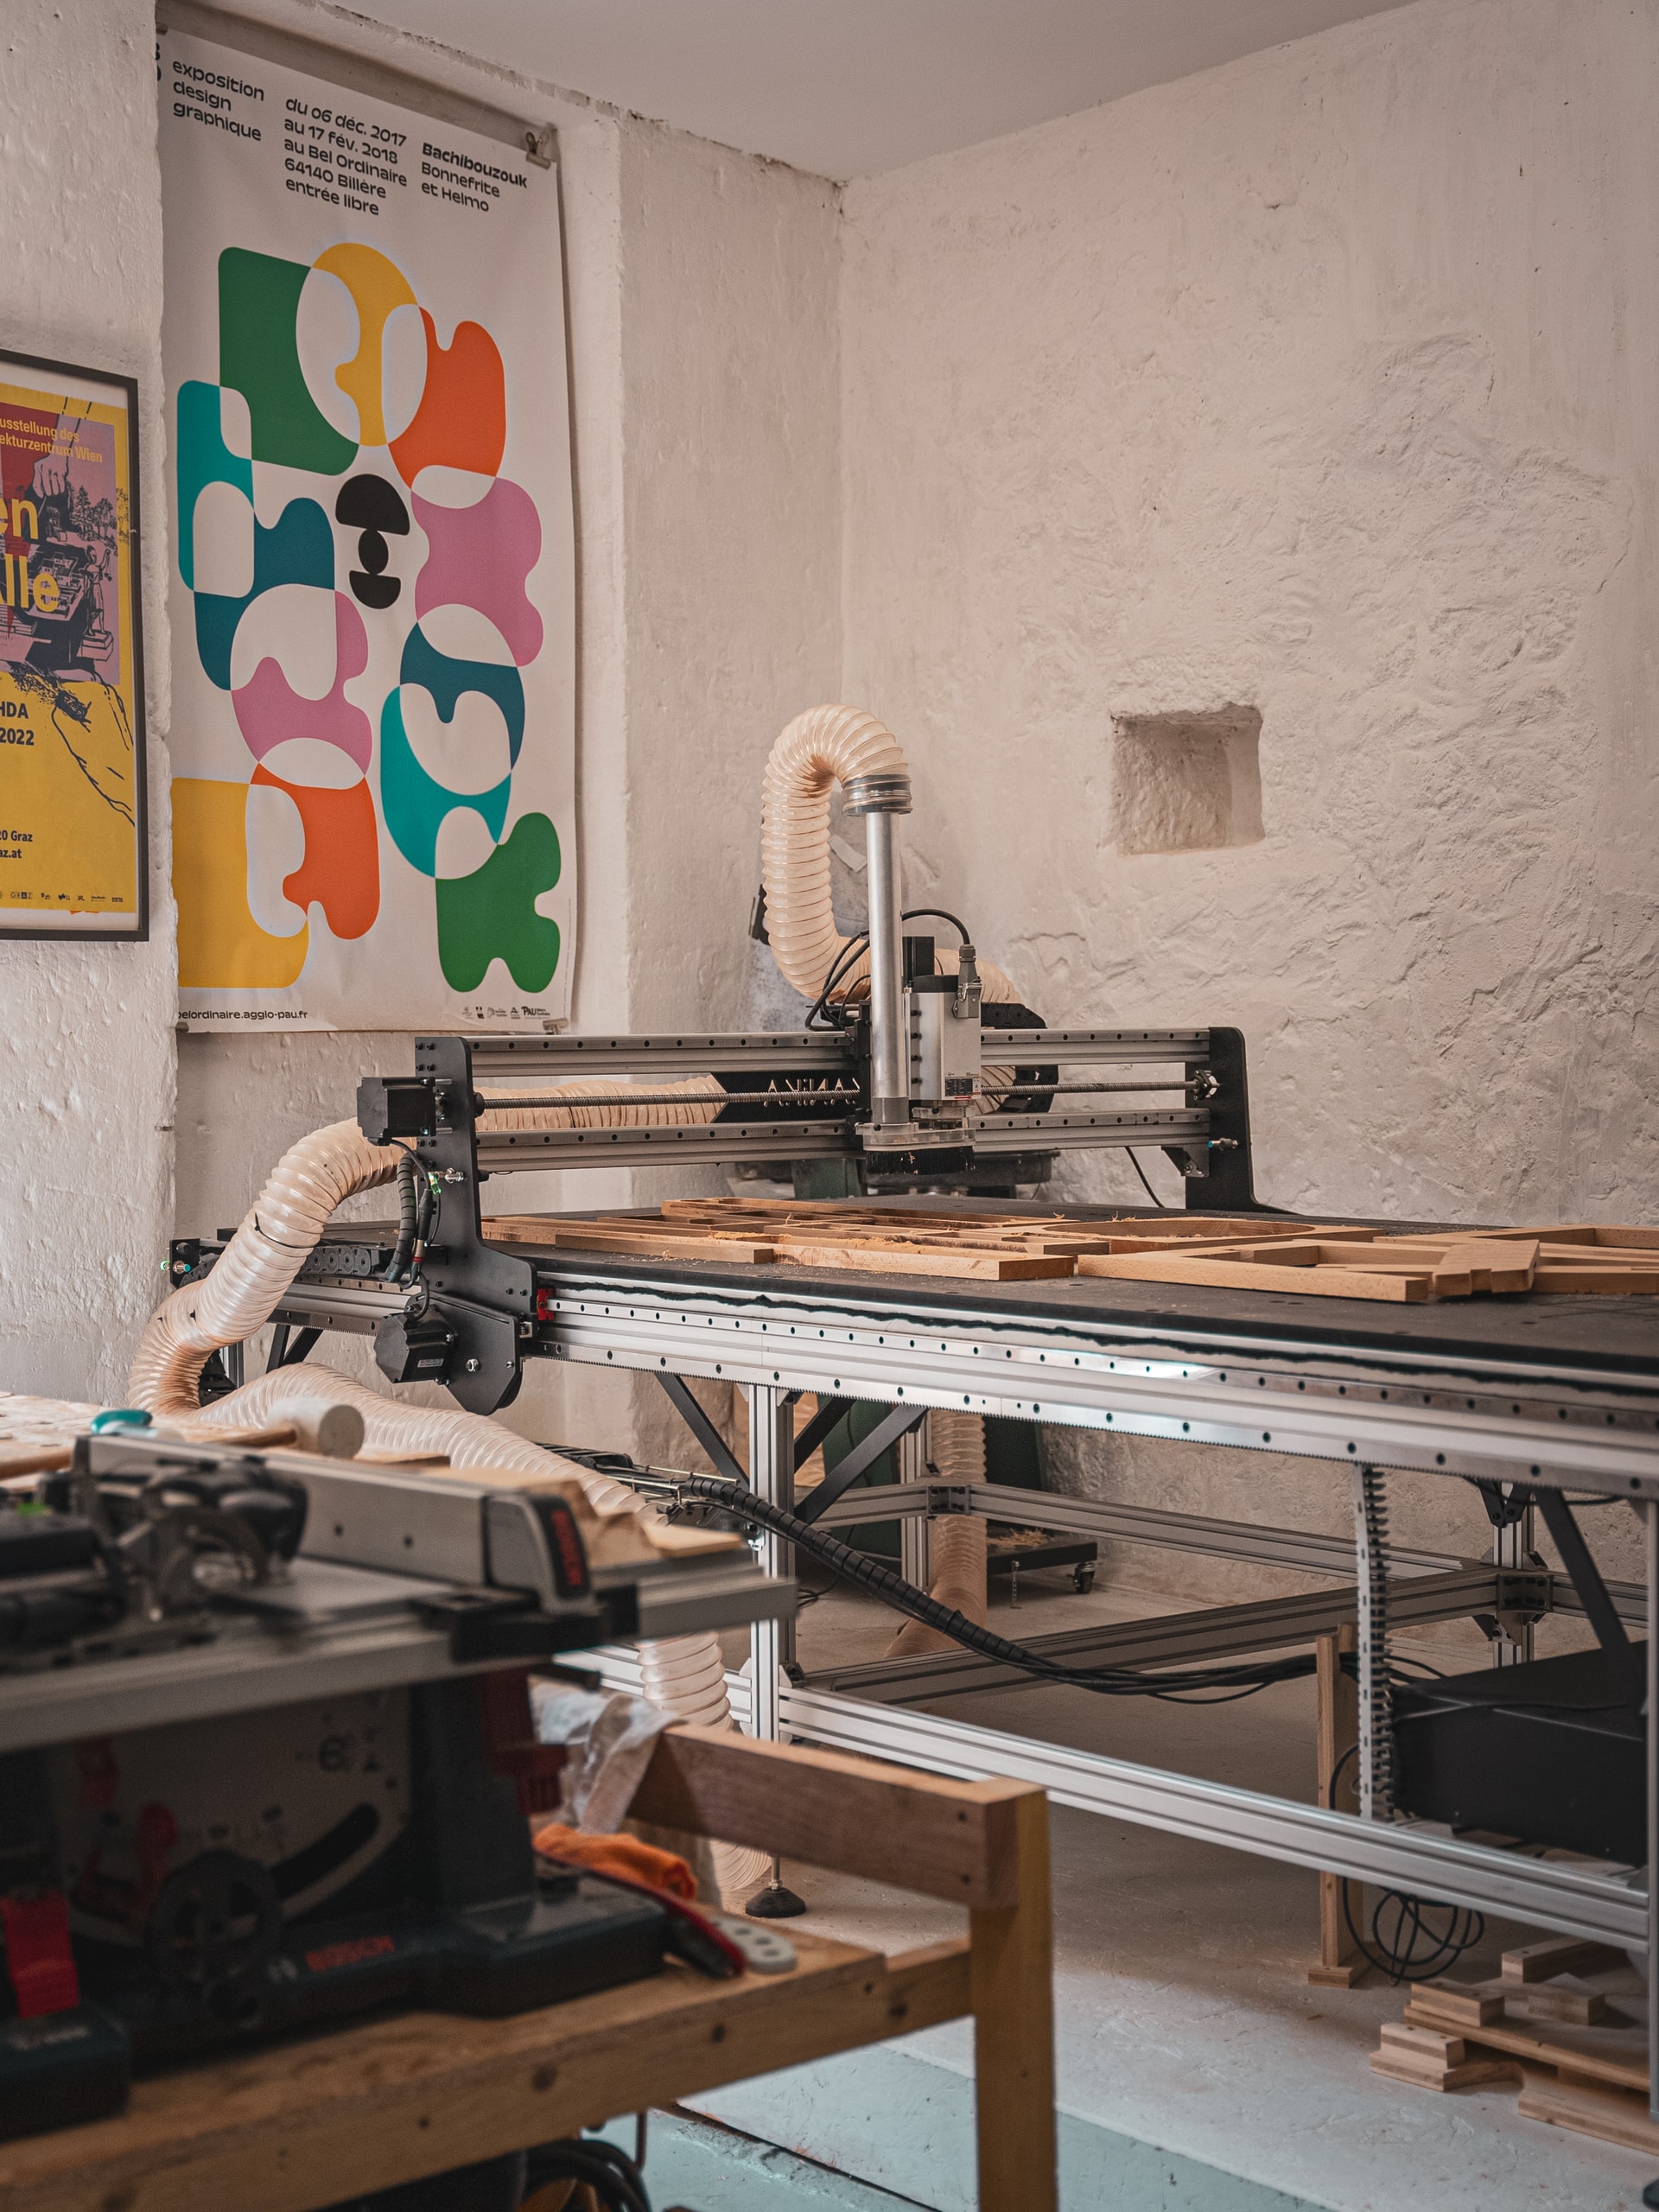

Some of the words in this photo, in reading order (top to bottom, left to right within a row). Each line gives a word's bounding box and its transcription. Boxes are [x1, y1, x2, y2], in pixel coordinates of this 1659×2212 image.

[173, 60, 264, 101] exposition
[173, 81, 232, 111] design
[173, 102, 262, 141] graphique
[284, 118, 304, 135] au
[308, 126, 325, 140] 17
[328, 131, 358, 152] fév.
[362, 143, 397, 164] 2018
[285, 99, 308, 115] du
[335, 115, 366, 135] déc.
[370, 125, 407, 147] 2017
[284, 138, 304, 155] au
[308, 145, 332, 163] Bel
[336, 154, 407, 187] Ordinaire
[284, 158, 334, 183] 64140
[338, 174, 386, 198] Billère
[422, 162, 500, 198] Bonnefrite
[423, 143, 527, 188] Bachibouzouk
[286, 178, 340, 205] entrée
[344, 194, 378, 215] libre
[422, 182, 438, 196] et
[442, 187, 489, 212] Helmo
[60, 428, 79, 442] des
[75, 446, 103, 463] Wien
[0, 553, 60, 612] lle
[11, 830, 33, 842] Graz
